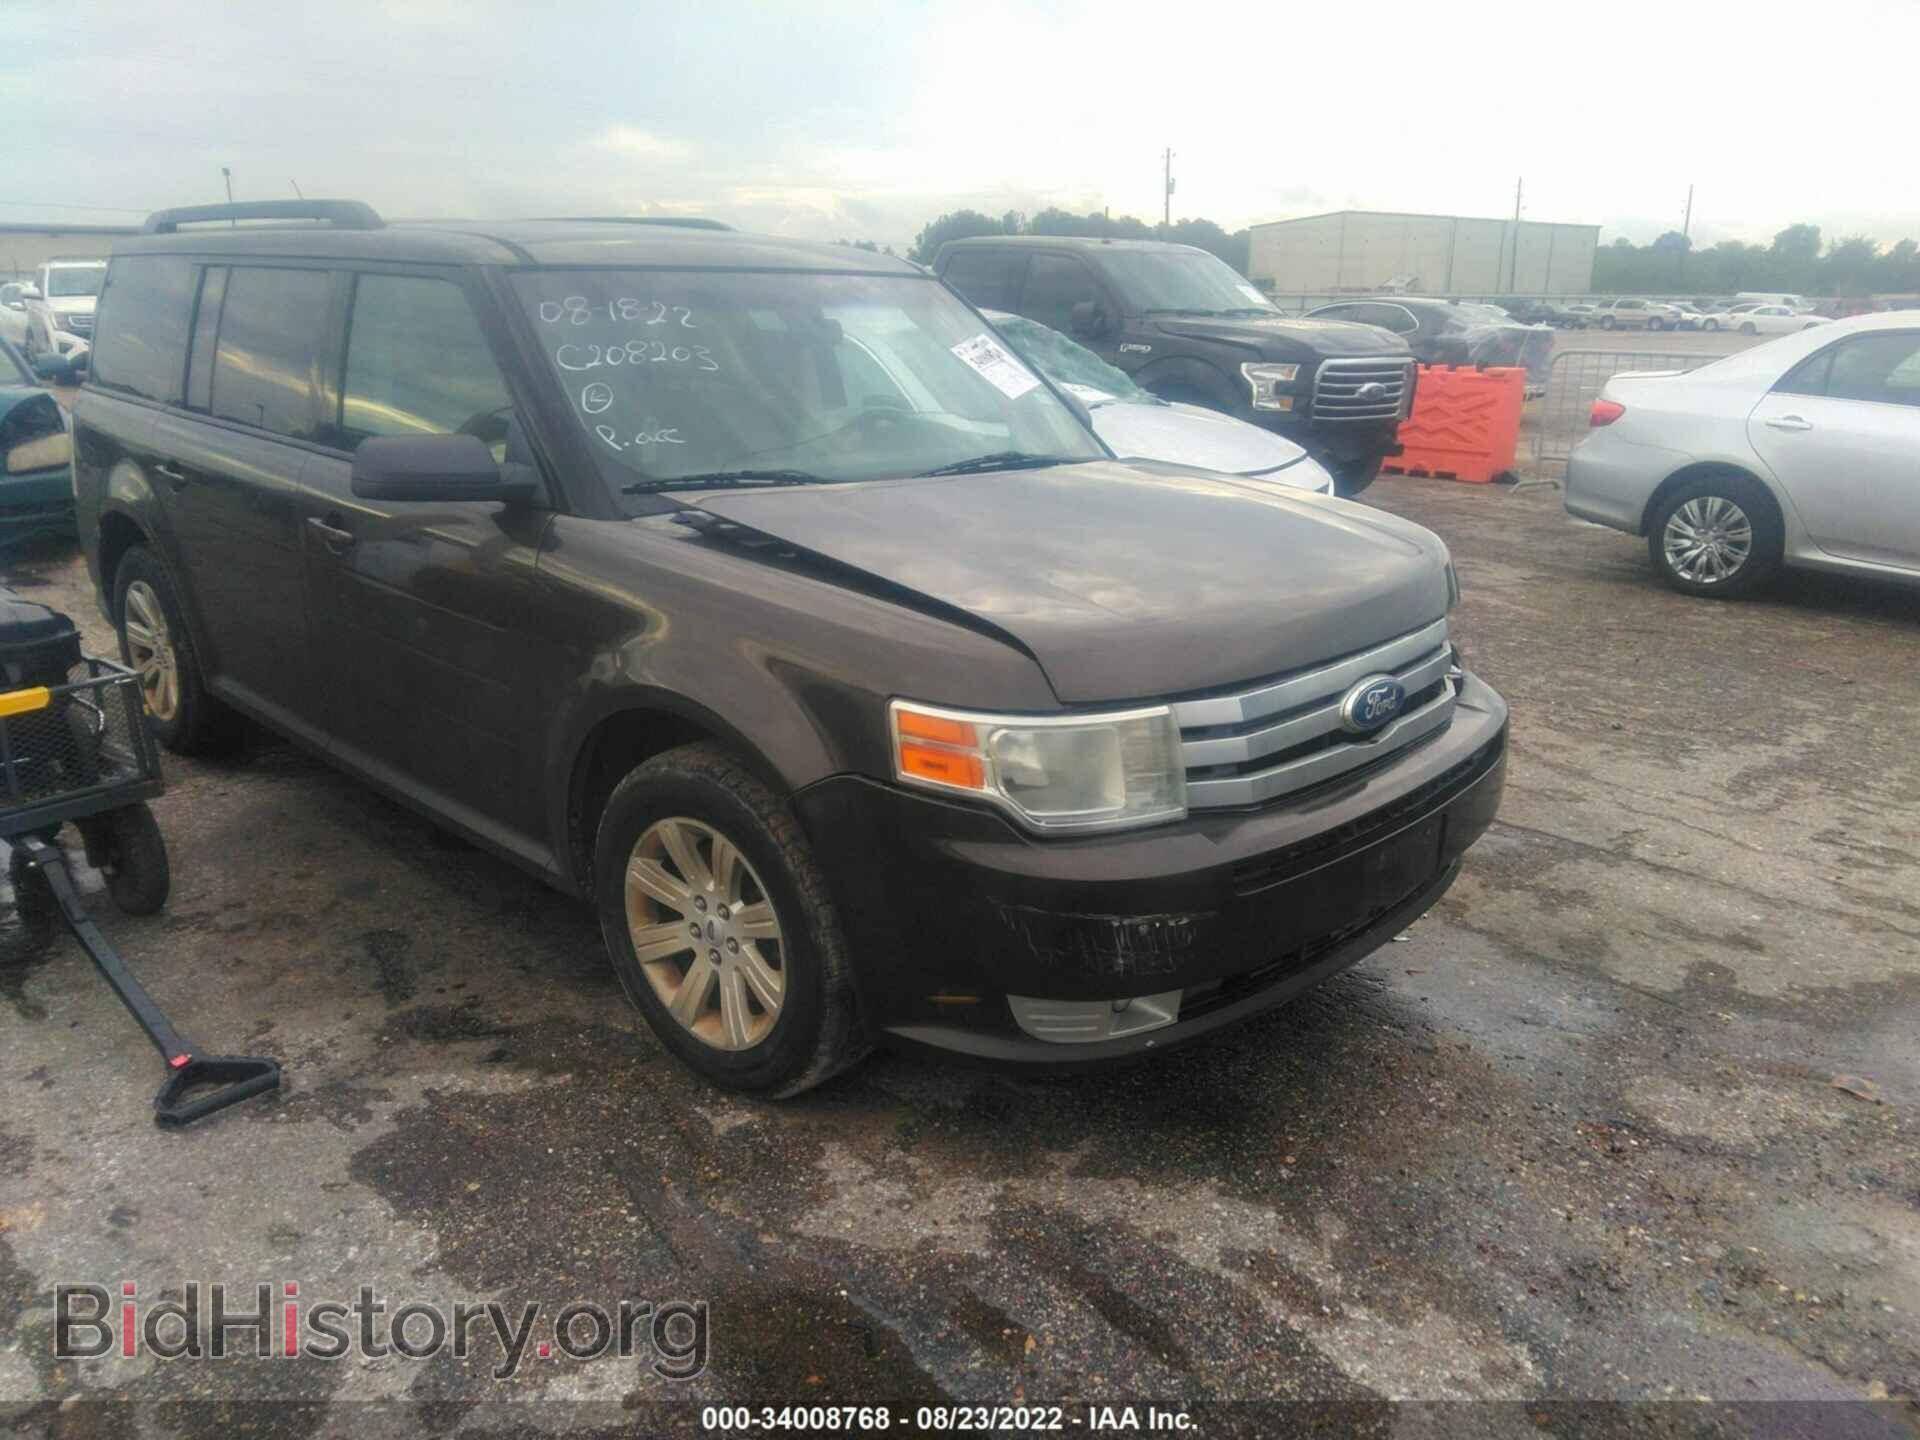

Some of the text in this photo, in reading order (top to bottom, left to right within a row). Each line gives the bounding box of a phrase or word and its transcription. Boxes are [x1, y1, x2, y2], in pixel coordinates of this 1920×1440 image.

[539, 296, 697, 328] 08-18-22
[556, 340, 720, 371] C208203
[1364, 685, 1397, 719] Ford
